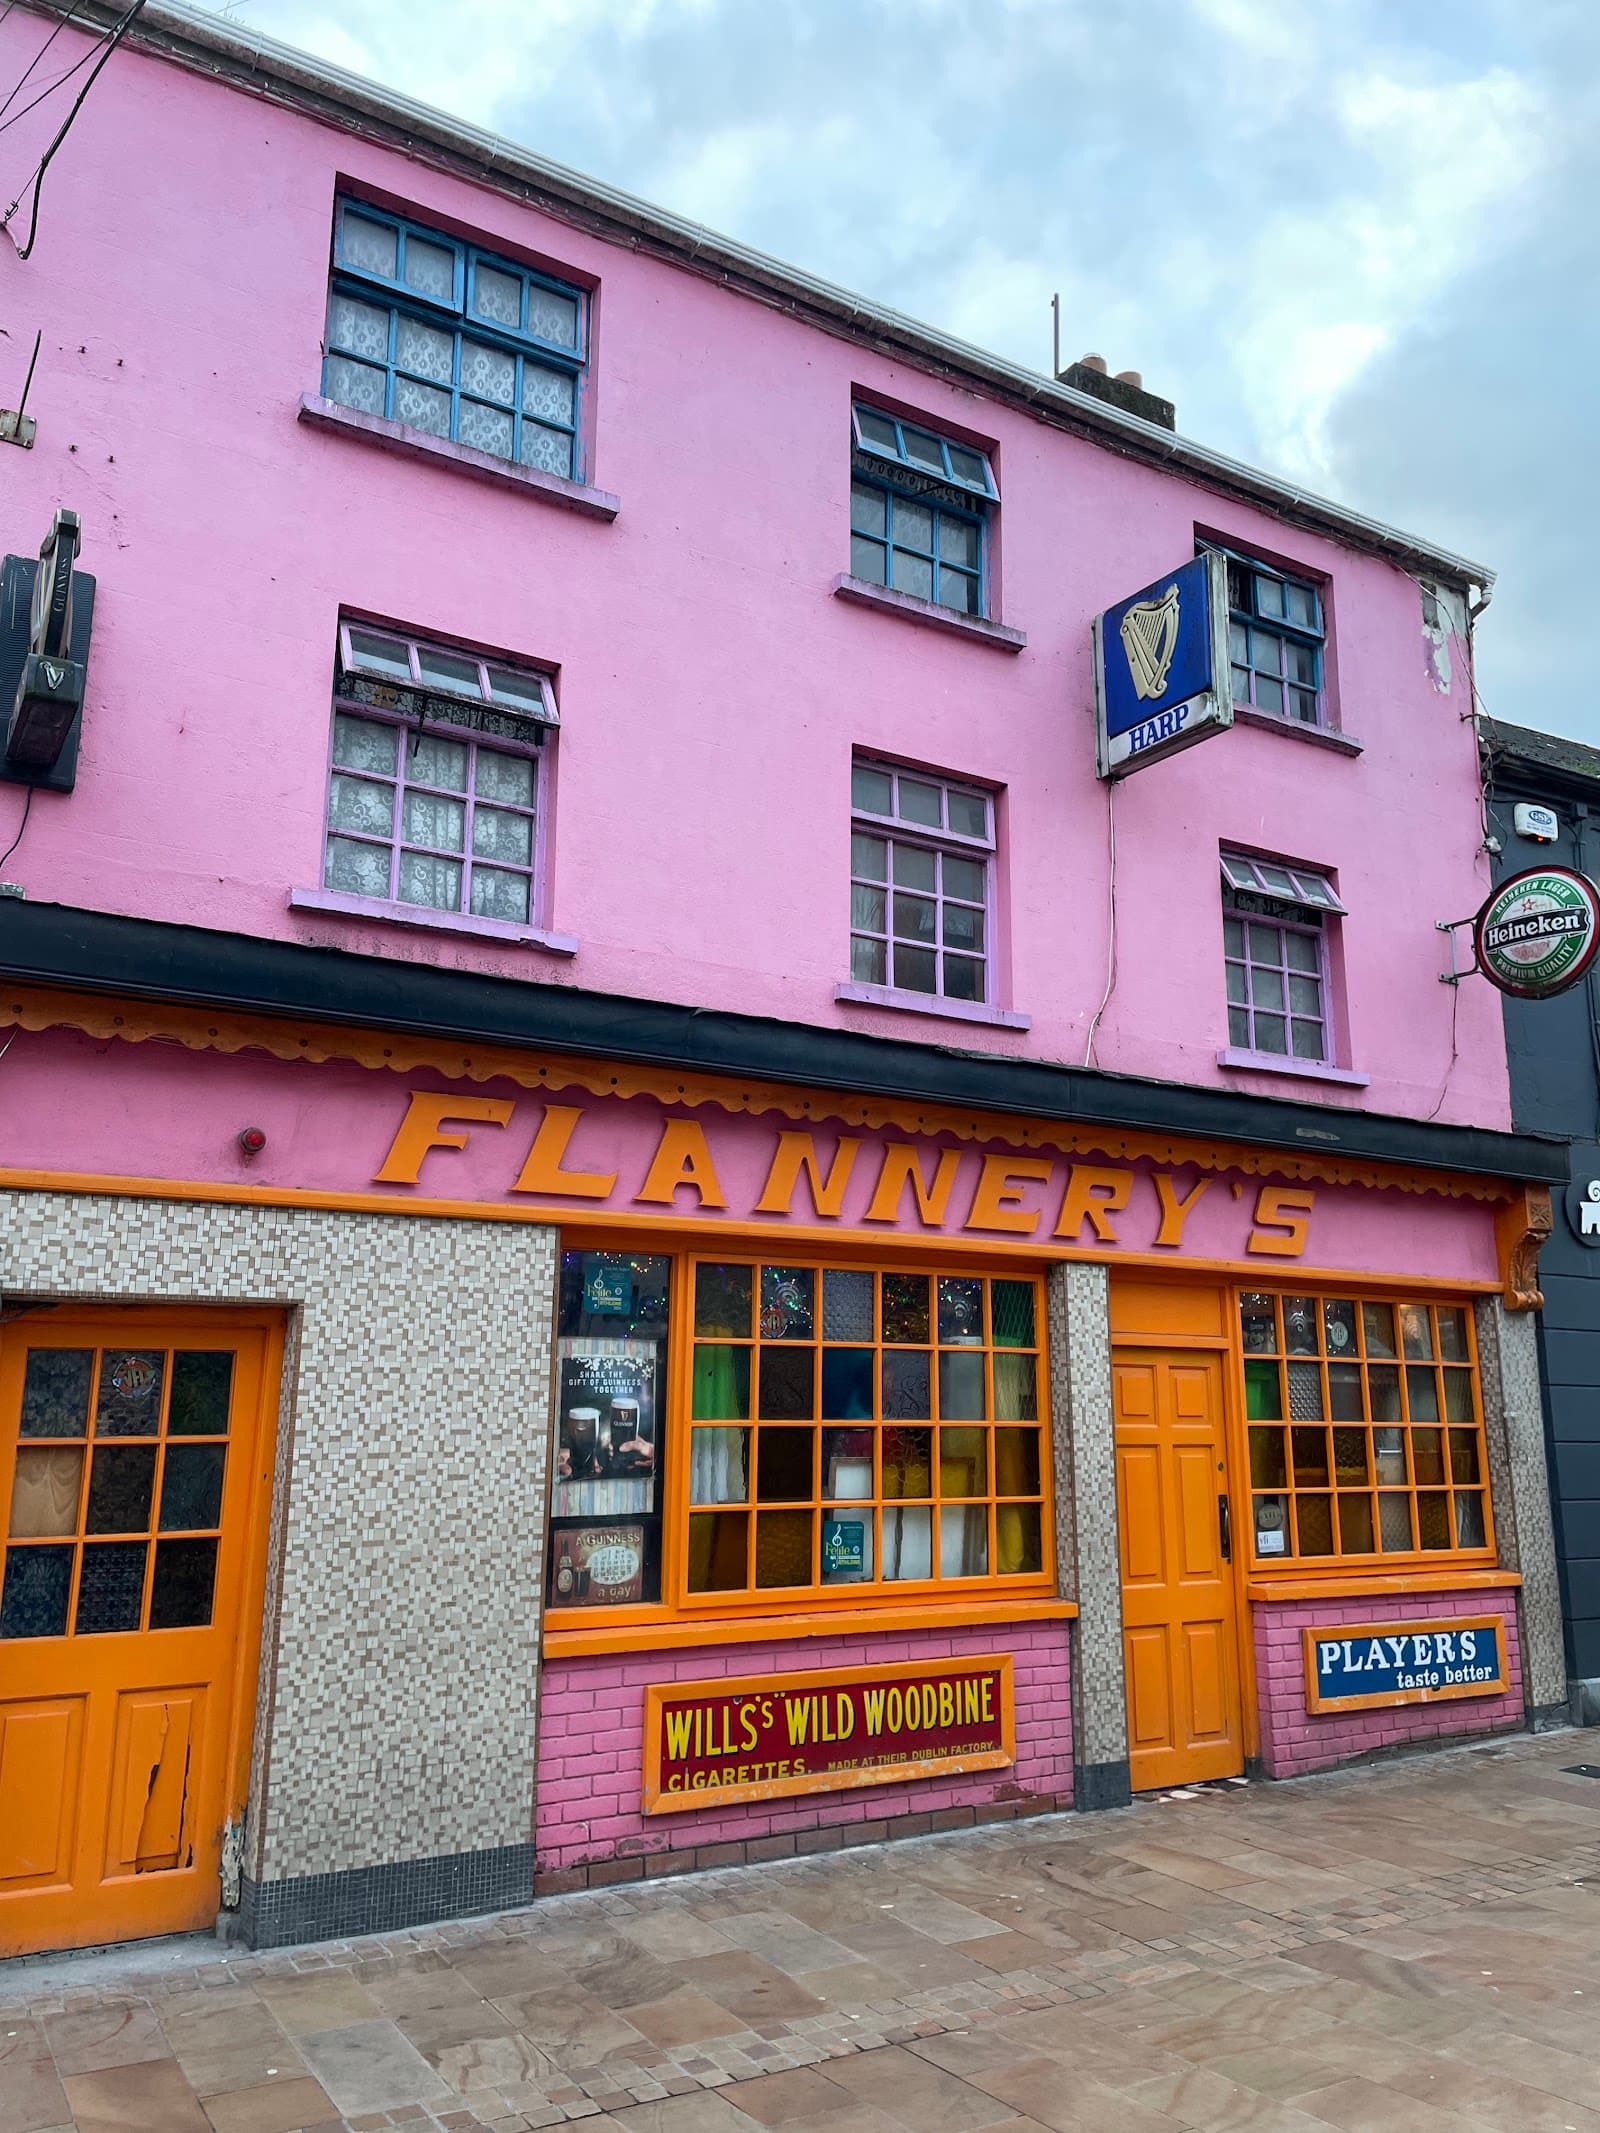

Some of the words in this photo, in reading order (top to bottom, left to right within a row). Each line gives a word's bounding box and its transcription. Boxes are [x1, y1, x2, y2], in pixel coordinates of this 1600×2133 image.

[1128, 704, 1190, 754] HARP
[1495, 880, 1539, 913] HEINEKEN
[1541, 880, 1571, 899] LAGER
[1488, 914, 1580, 947] Heineken
[1496, 957, 1536, 978] PREMIUM
[1538, 943, 1575, 977] QUALITY
[371, 1090, 1316, 1256] FLANNERY'S
[579, 1370, 605, 1378] SHARE
[608, 1370, 623, 1378] THE
[594, 1386, 634, 1394] TOGETHER
[575, 1536, 583, 1546] A
[587, 1533, 641, 1546] GUINNESS
[1320, 1631, 1477, 1674] PLAYER'S
[1397, 1671, 1439, 1689] taste
[1445, 1666, 1492, 1684] better
[665, 1695, 774, 1761] WILLS'S
[863, 1677, 995, 1737] WOODBINE
[828, 1759, 858, 1772] MADE
[862, 1757, 875, 1767] AT
[877, 1752, 907, 1765] THEIR
[912, 1746, 948, 1761] DUBLIN
